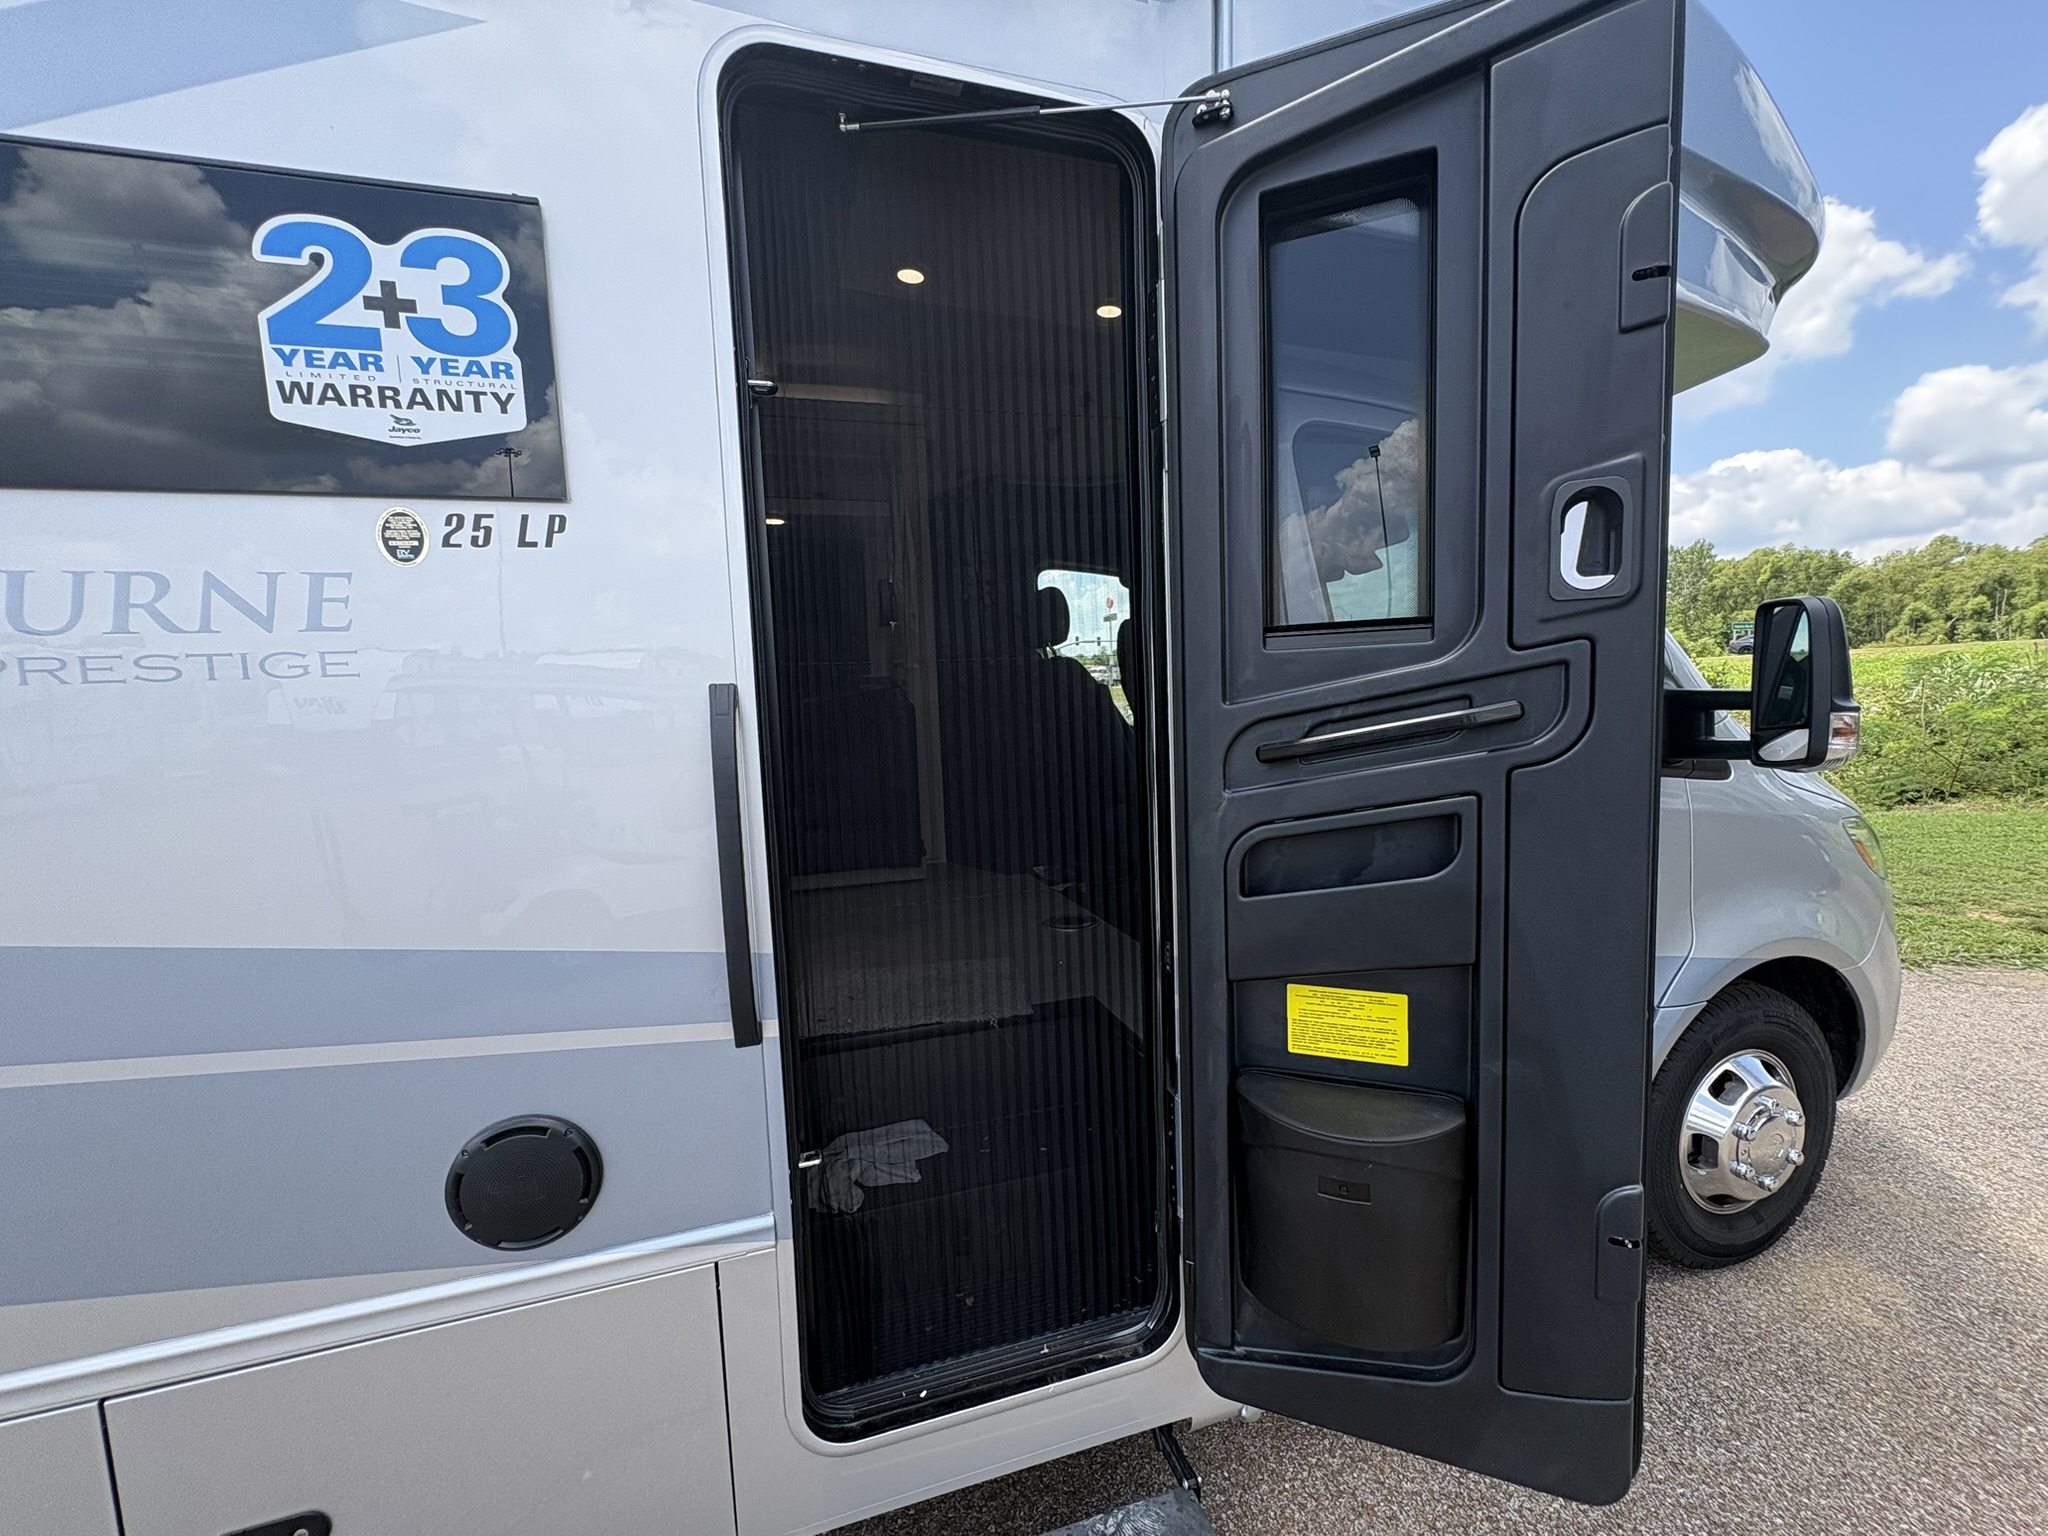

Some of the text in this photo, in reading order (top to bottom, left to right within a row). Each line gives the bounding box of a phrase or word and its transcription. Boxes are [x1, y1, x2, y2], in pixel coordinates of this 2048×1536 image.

[271, 347, 515, 380] YEAR YEAR
[285, 370, 517, 390] LIMITED STRUCTURAL
[275, 380, 516, 415] WARRANTY
[388, 426, 421, 434] Jayco
[441, 513, 494, 549] 25
[517, 514, 567, 549] LP
[0, 650, 361, 686] RESTIGE
